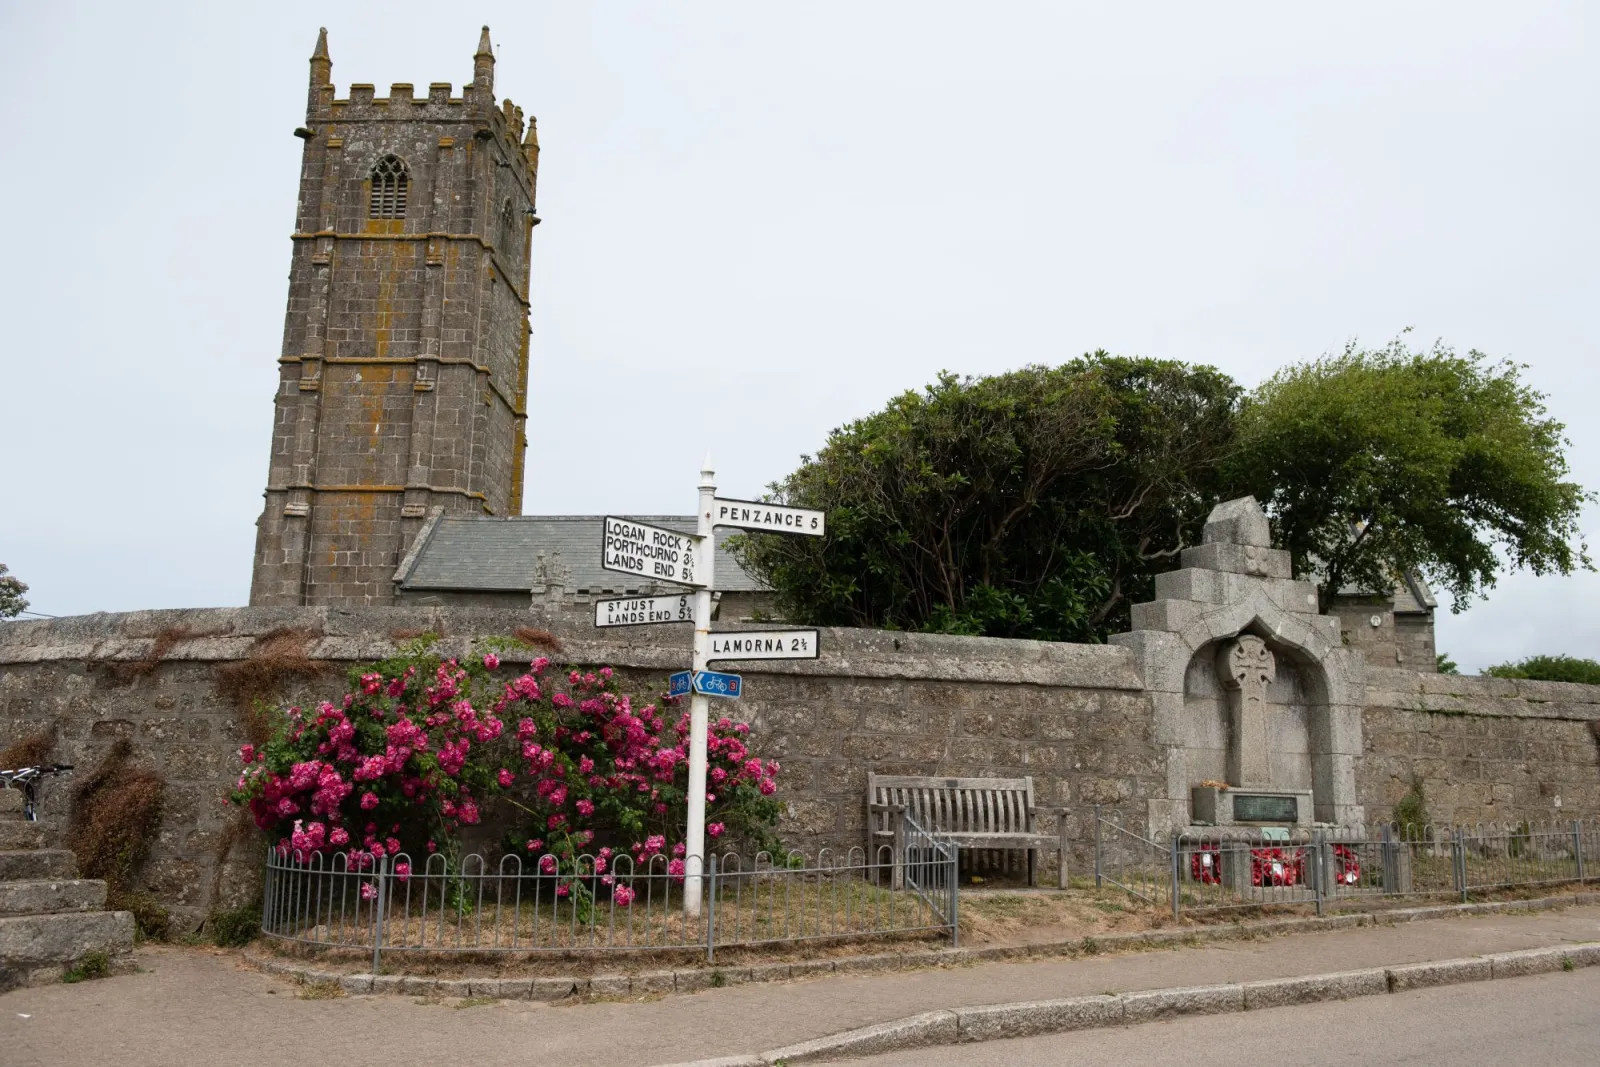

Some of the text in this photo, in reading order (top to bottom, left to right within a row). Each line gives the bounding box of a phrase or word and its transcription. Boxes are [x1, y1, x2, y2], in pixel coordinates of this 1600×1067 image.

[720, 506, 818, 529] PENZANCE 5
[607, 521, 692, 552] LOGAN ROCK 2
[607, 536, 679, 563] PORTHCURNO
[606, 551, 644, 571] LANDS
[654, 562, 675, 577] END
[624, 599, 655, 611] JUST
[679, 595, 687, 607] 5
[608, 611, 645, 624] LANDS
[649, 610, 671, 621] END
[713, 639, 783, 653] LAMORNA
[730, 681, 736, 690] 3
